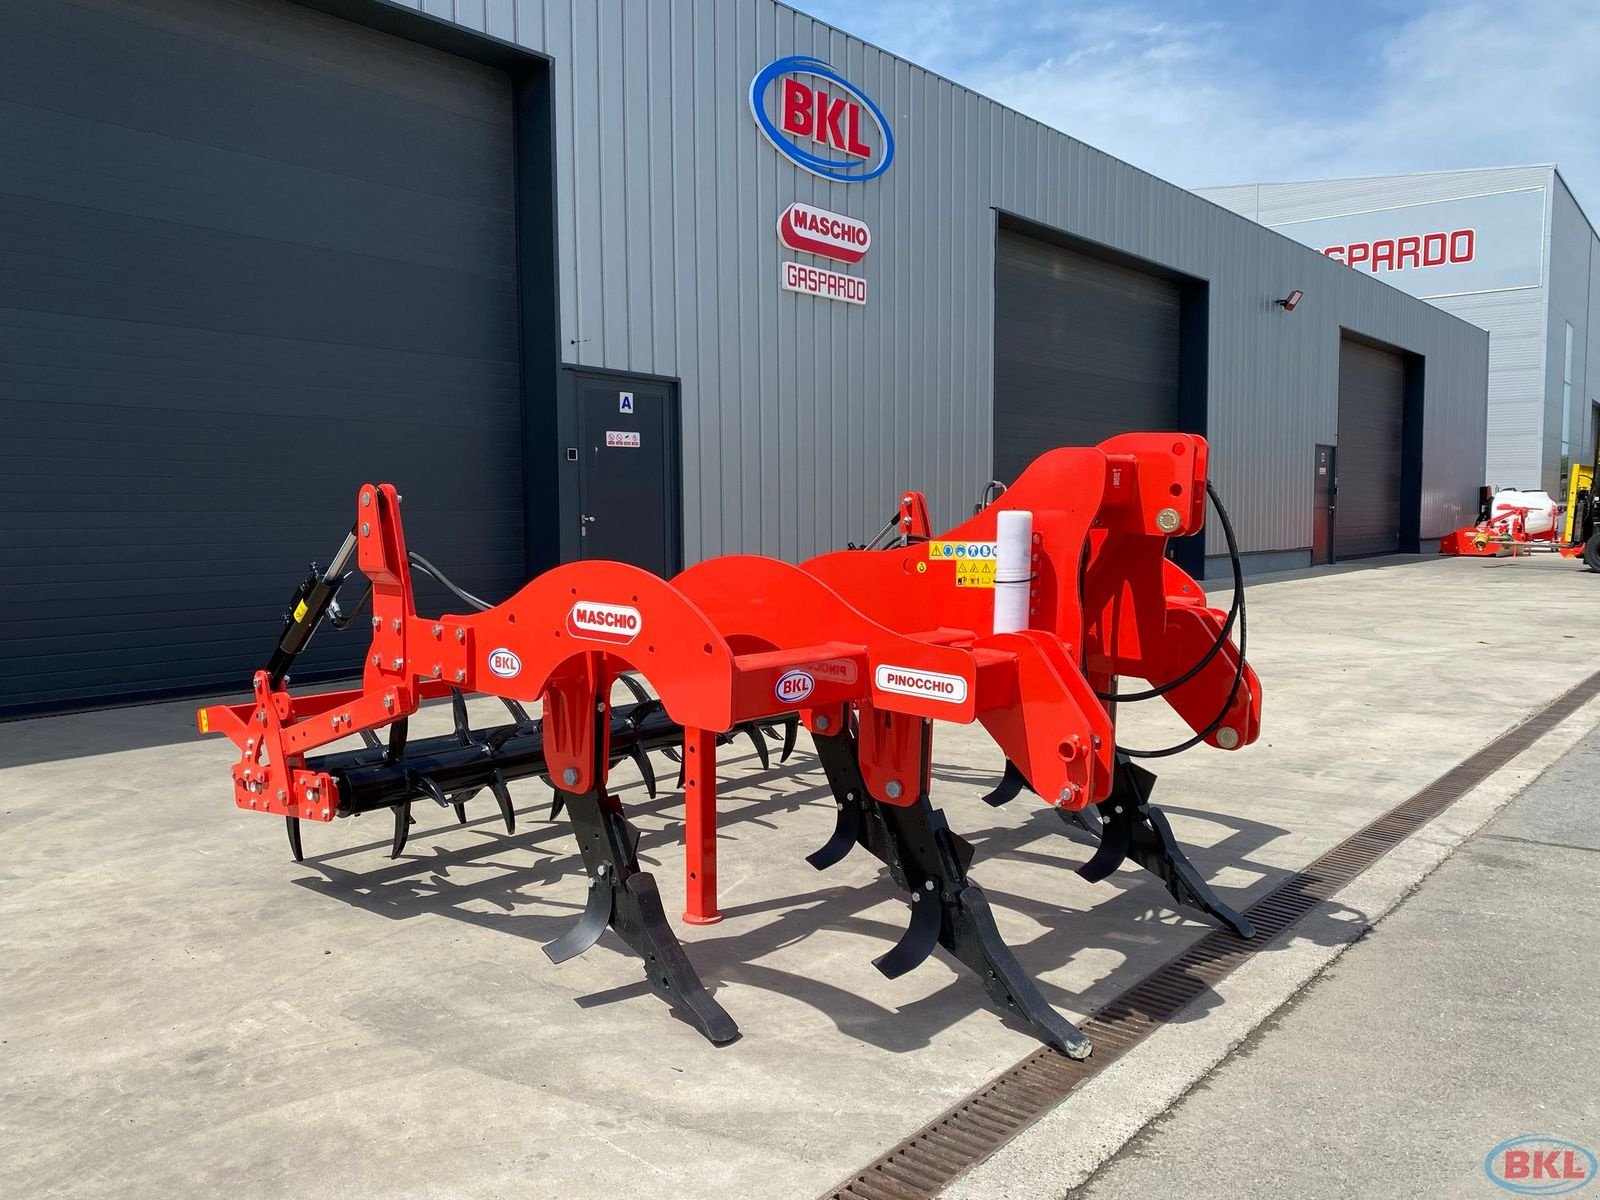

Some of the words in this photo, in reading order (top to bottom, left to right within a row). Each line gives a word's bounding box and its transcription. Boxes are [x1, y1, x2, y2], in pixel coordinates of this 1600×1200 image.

[781, 78, 870, 159] BKL
[793, 208, 867, 246] MASCHIO
[1315, 229, 1475, 273] SPARDO
[787, 264, 866, 302] GASPARDO
[621, 396, 632, 409] A
[576, 608, 637, 630] MASCHIO
[494, 655, 517, 670] BKL
[783, 677, 809, 694] BKL
[887, 673, 954, 694] PINOCCHIO
